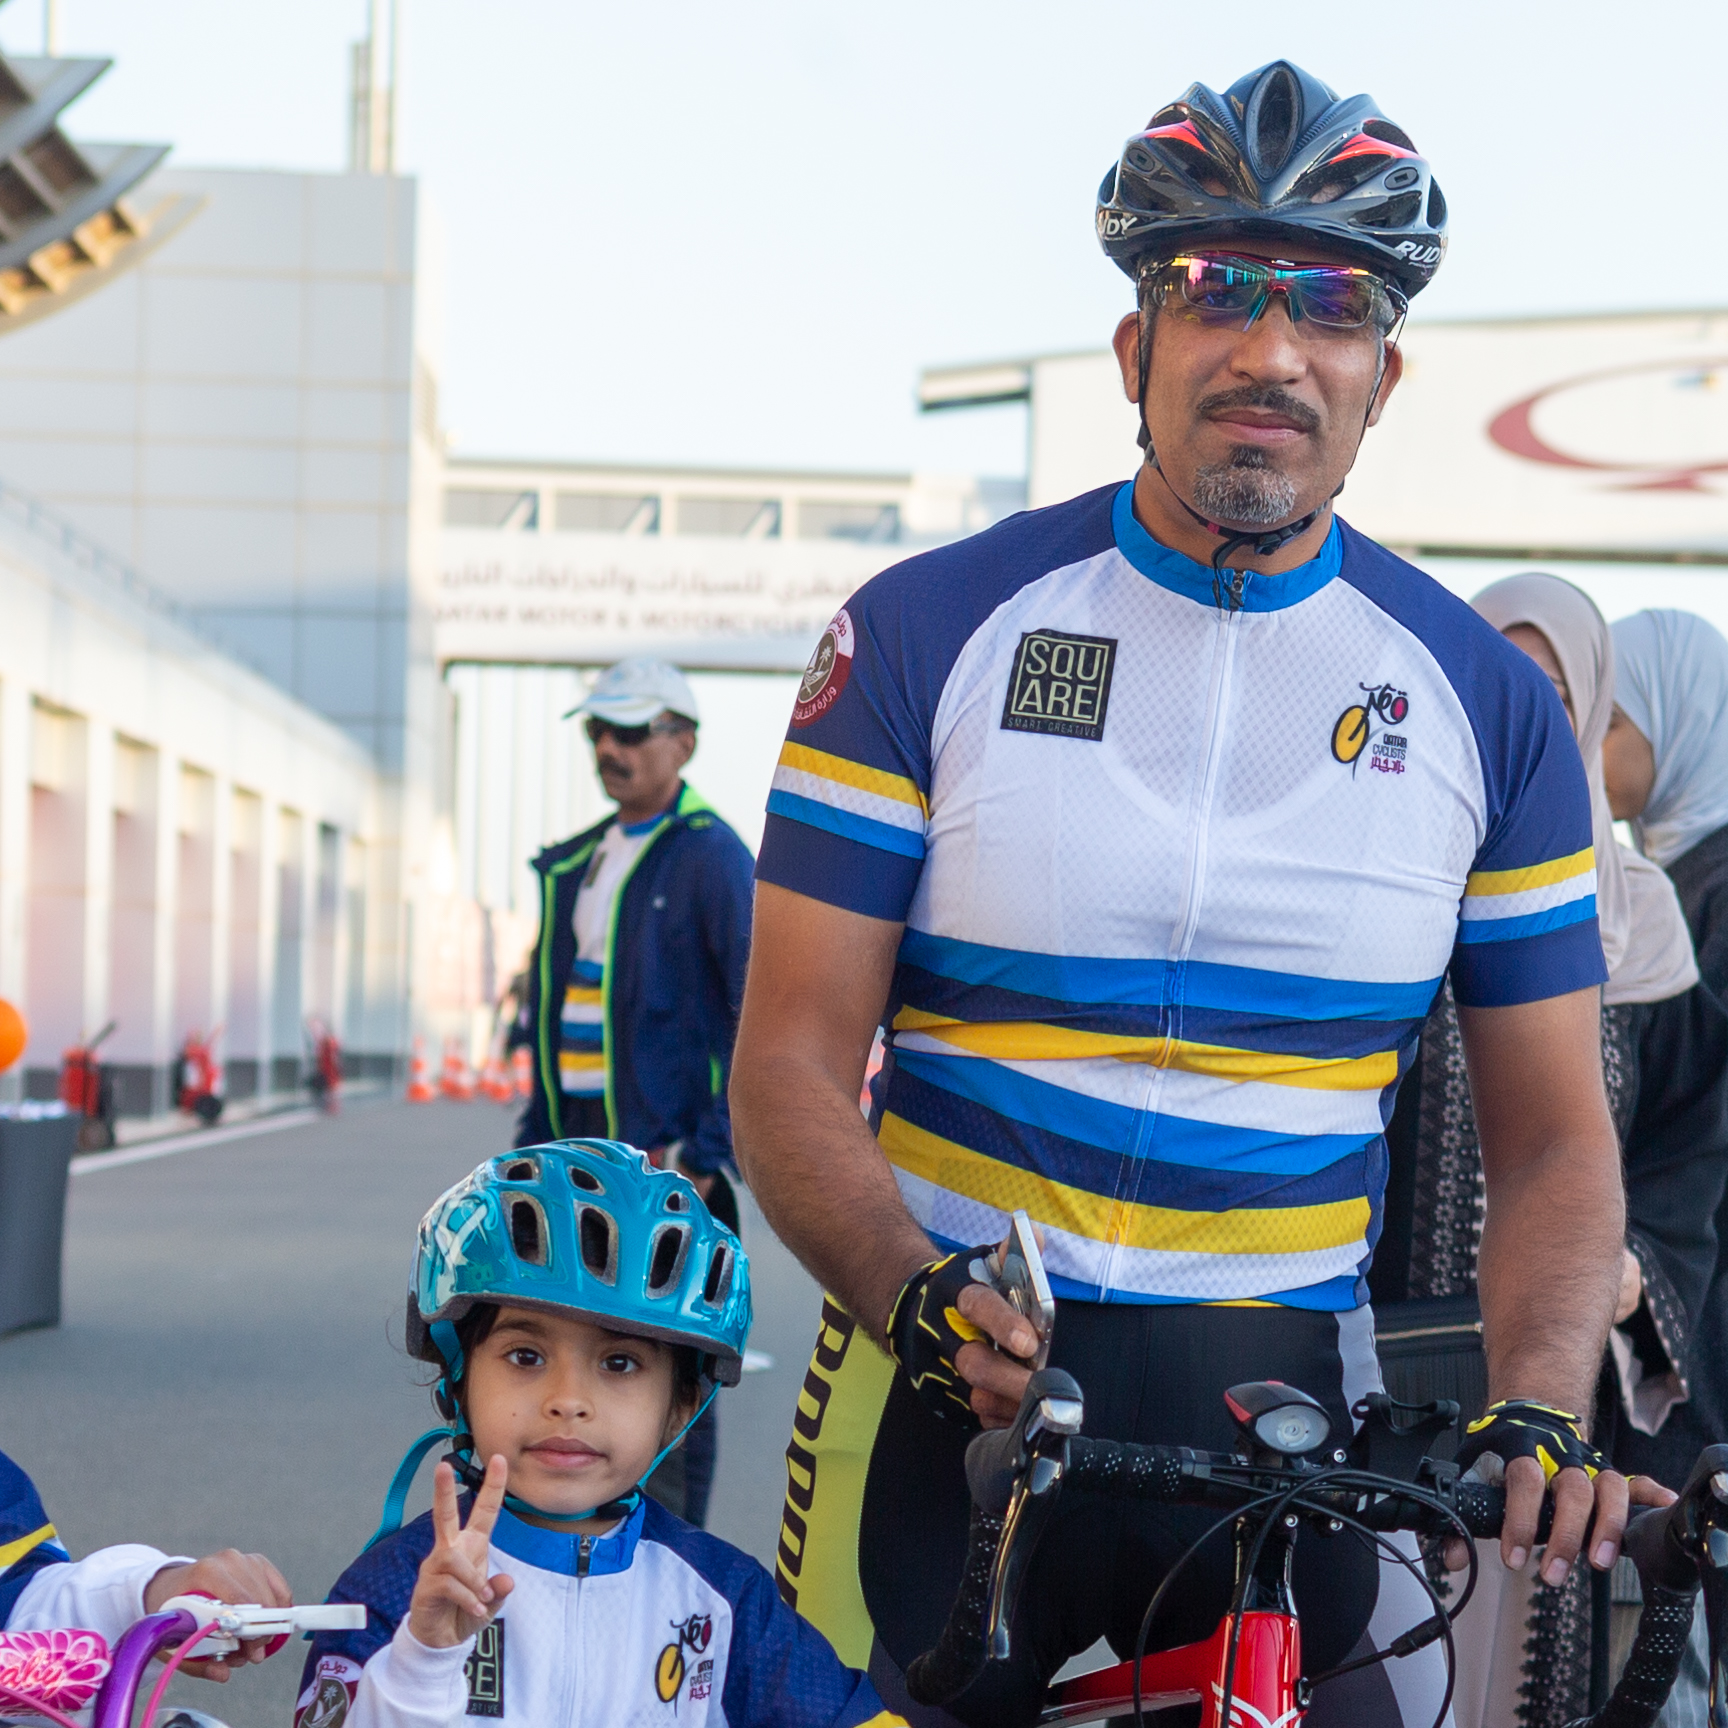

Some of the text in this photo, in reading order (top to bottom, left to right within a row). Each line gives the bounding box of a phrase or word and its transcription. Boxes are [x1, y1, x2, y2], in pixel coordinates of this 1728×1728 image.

[1395, 240, 1442, 263] RUD
[1025, 640, 1102, 681] SQU
[1017, 679, 1097, 719] ARE
[1007, 718, 1097, 738] SMART CREATIVE
[1372, 743, 1406, 760] CYCLISTS
[465, 1661, 494, 1696] RE
